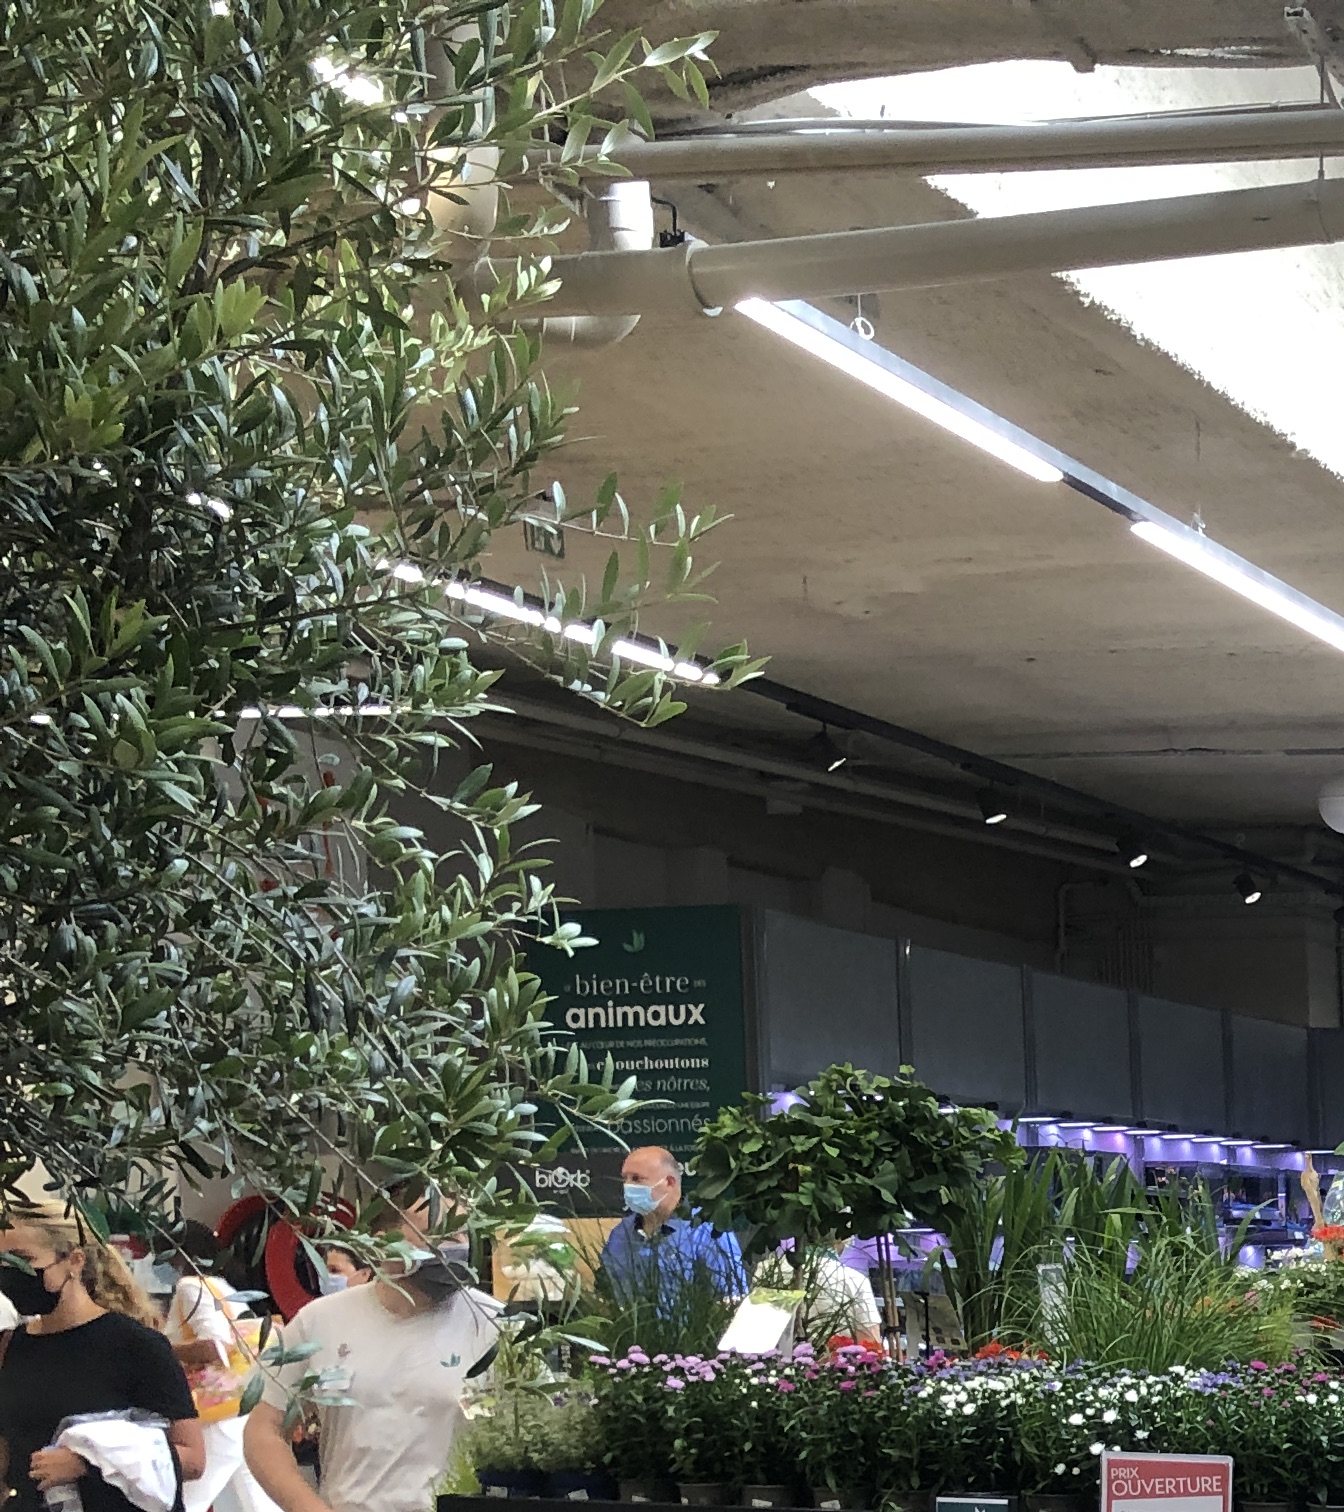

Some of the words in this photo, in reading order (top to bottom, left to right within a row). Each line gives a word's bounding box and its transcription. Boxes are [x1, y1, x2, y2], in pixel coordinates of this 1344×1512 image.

[575, 972, 690, 996] bien-être
[565, 1000, 706, 1029] animaux
[596, 1056, 710, 1072] couchoutons
[1110, 1466, 1140, 1480] PRIX
[1111, 1475, 1223, 1497] OUVERTURE
